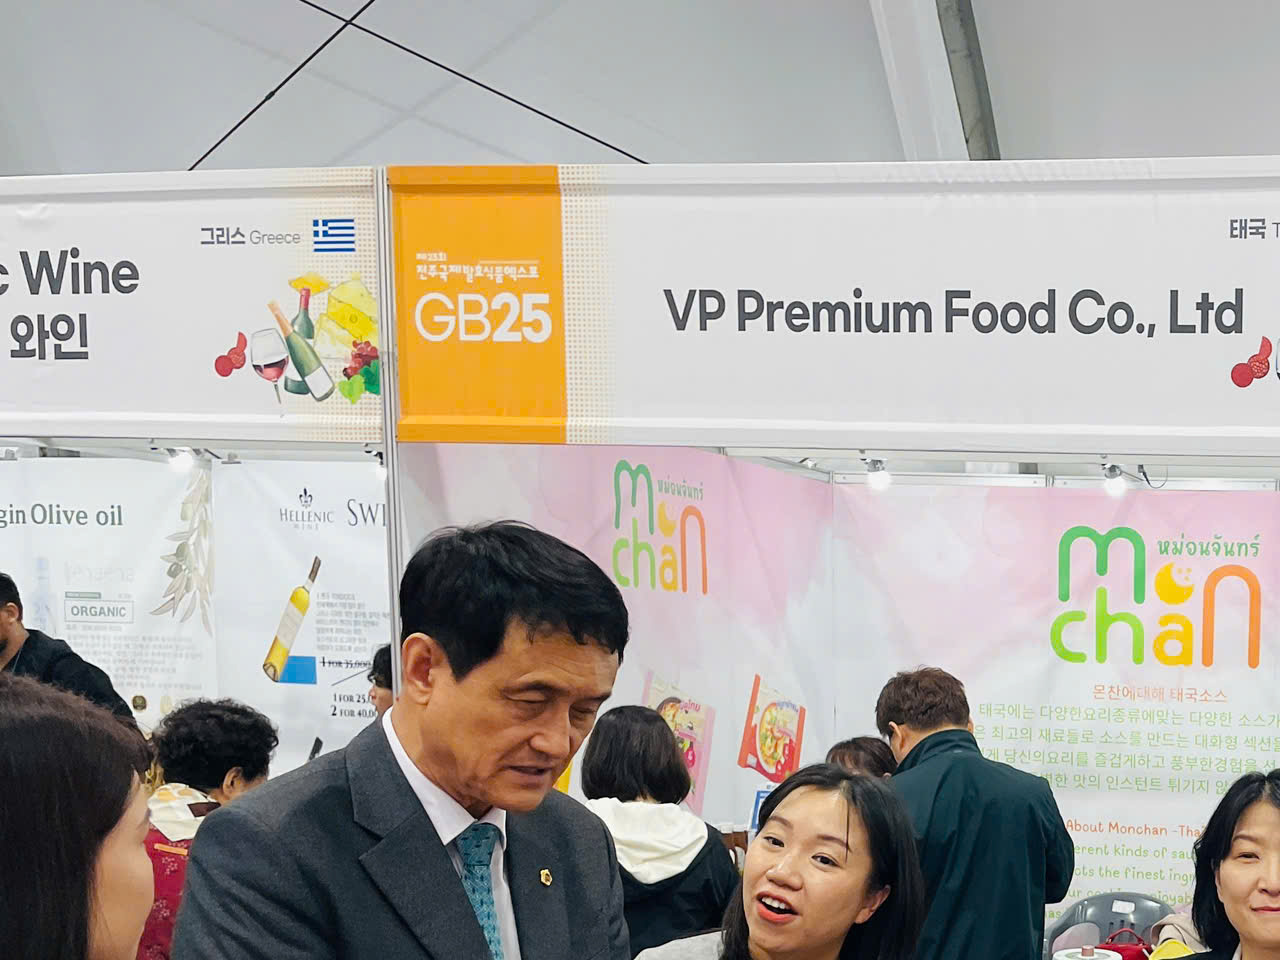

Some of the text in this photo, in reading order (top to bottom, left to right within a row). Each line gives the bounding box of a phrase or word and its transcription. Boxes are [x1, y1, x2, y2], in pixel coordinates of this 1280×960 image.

[200, 226, 301, 245] 그리스 Greece
[1230, 218, 1266, 240] 태국
[20, 247, 140, 295] Wine
[415, 292, 552, 343] GB25
[663, 286, 1244, 338] VP Premium Food Co., Ltd
[10, 313, 89, 360] 와인
[31, 503, 124, 526] Olive oil
[279, 508, 335, 523] HELLENIC
[71, 605, 127, 617] ORGANIC
[339, 694, 355, 702] FOR
[1170, 687, 1228, 703] 태국소스
[331, 705, 355, 717] 2 FOR
[979, 703, 1036, 720] 태국에는
[1190, 710, 1232, 728] 다양한
[1239, 713, 1280, 729] 소스가
[991, 725, 1033, 742] 최고의
[1147, 732, 1190, 749] 만드는
[1194, 734, 1238, 751] 대화형
[1095, 751, 1166, 769] 즐겁게하고
[1106, 775, 1164, 792] 인스턴트
[1066, 819, 1168, 836] About Monchan
[1114, 844, 1149, 858] kinds
[1153, 848, 1168, 859] of
[1098, 866, 1166, 881] the finest
